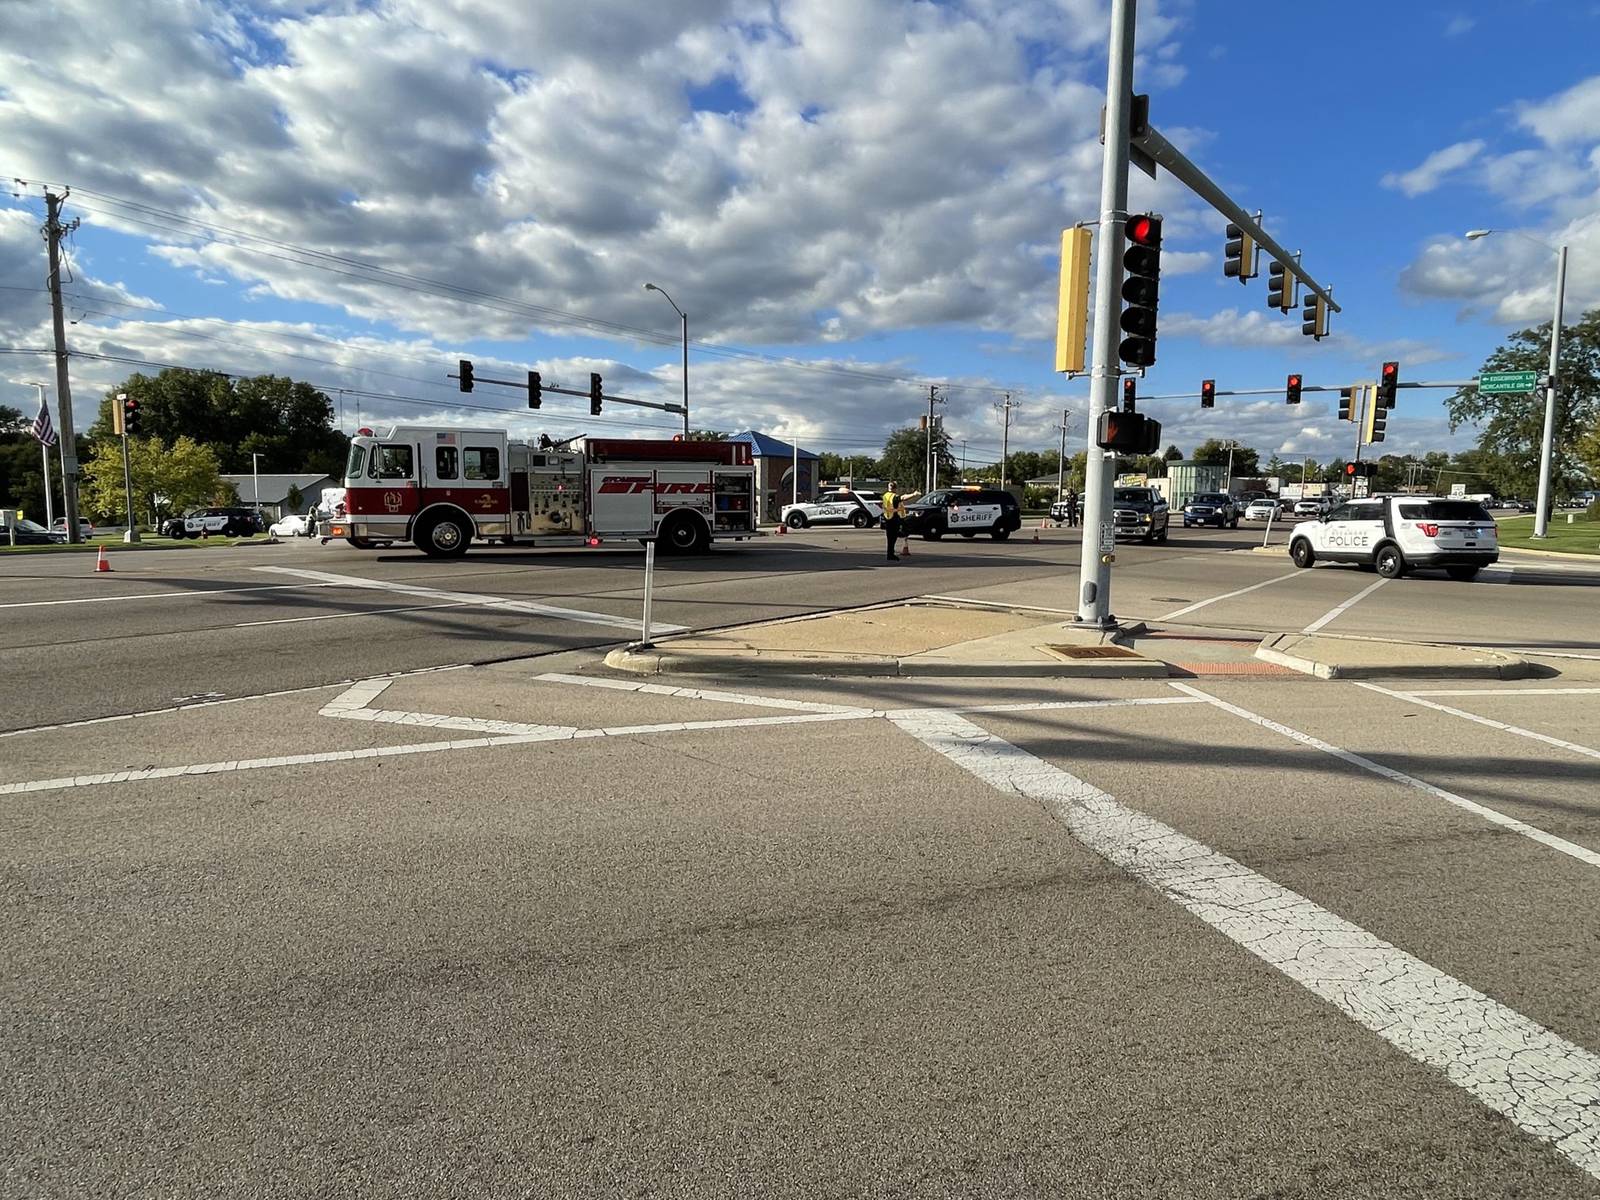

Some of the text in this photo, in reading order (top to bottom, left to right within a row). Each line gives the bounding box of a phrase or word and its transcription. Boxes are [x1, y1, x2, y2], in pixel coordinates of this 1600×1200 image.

[481, 494, 491, 508] 2
[961, 513, 992, 521] SHERIFF
[1328, 536, 1369, 546] POLICE
